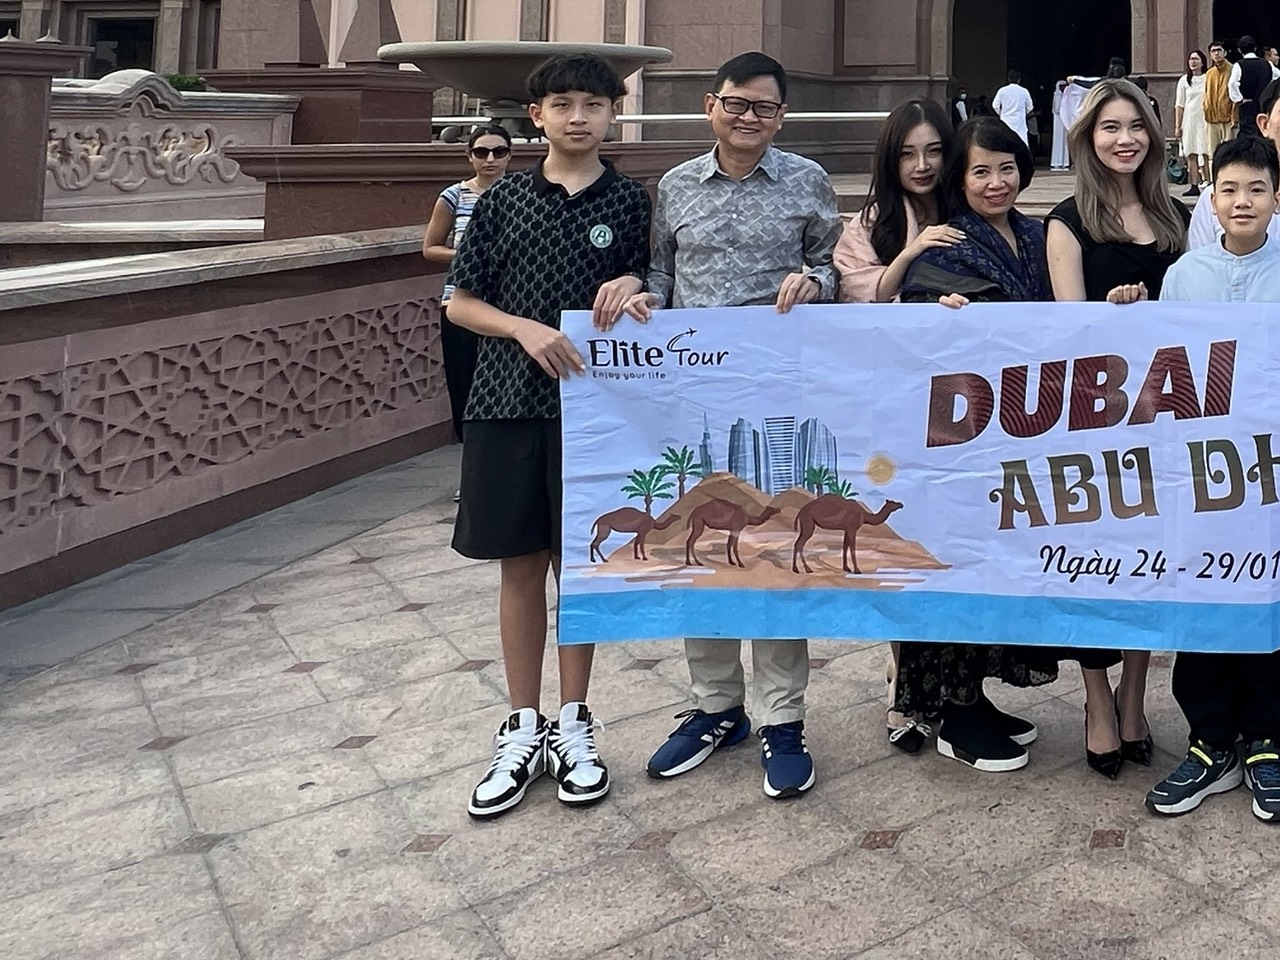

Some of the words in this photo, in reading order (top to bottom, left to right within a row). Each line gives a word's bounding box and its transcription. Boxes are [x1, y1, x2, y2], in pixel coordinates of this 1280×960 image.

[586, 339, 664, 367] Elite
[667, 331, 730, 366] Tour
[592, 371, 621, 380] Enjoy
[623, 372, 646, 380] your
[648, 371, 666, 380] life
[926, 339, 1238, 448] DUBAI
[988, 446, 1160, 530] ABU
[1039, 544, 1123, 585] Ngày
[1130, 548, 1168, 581] 24
